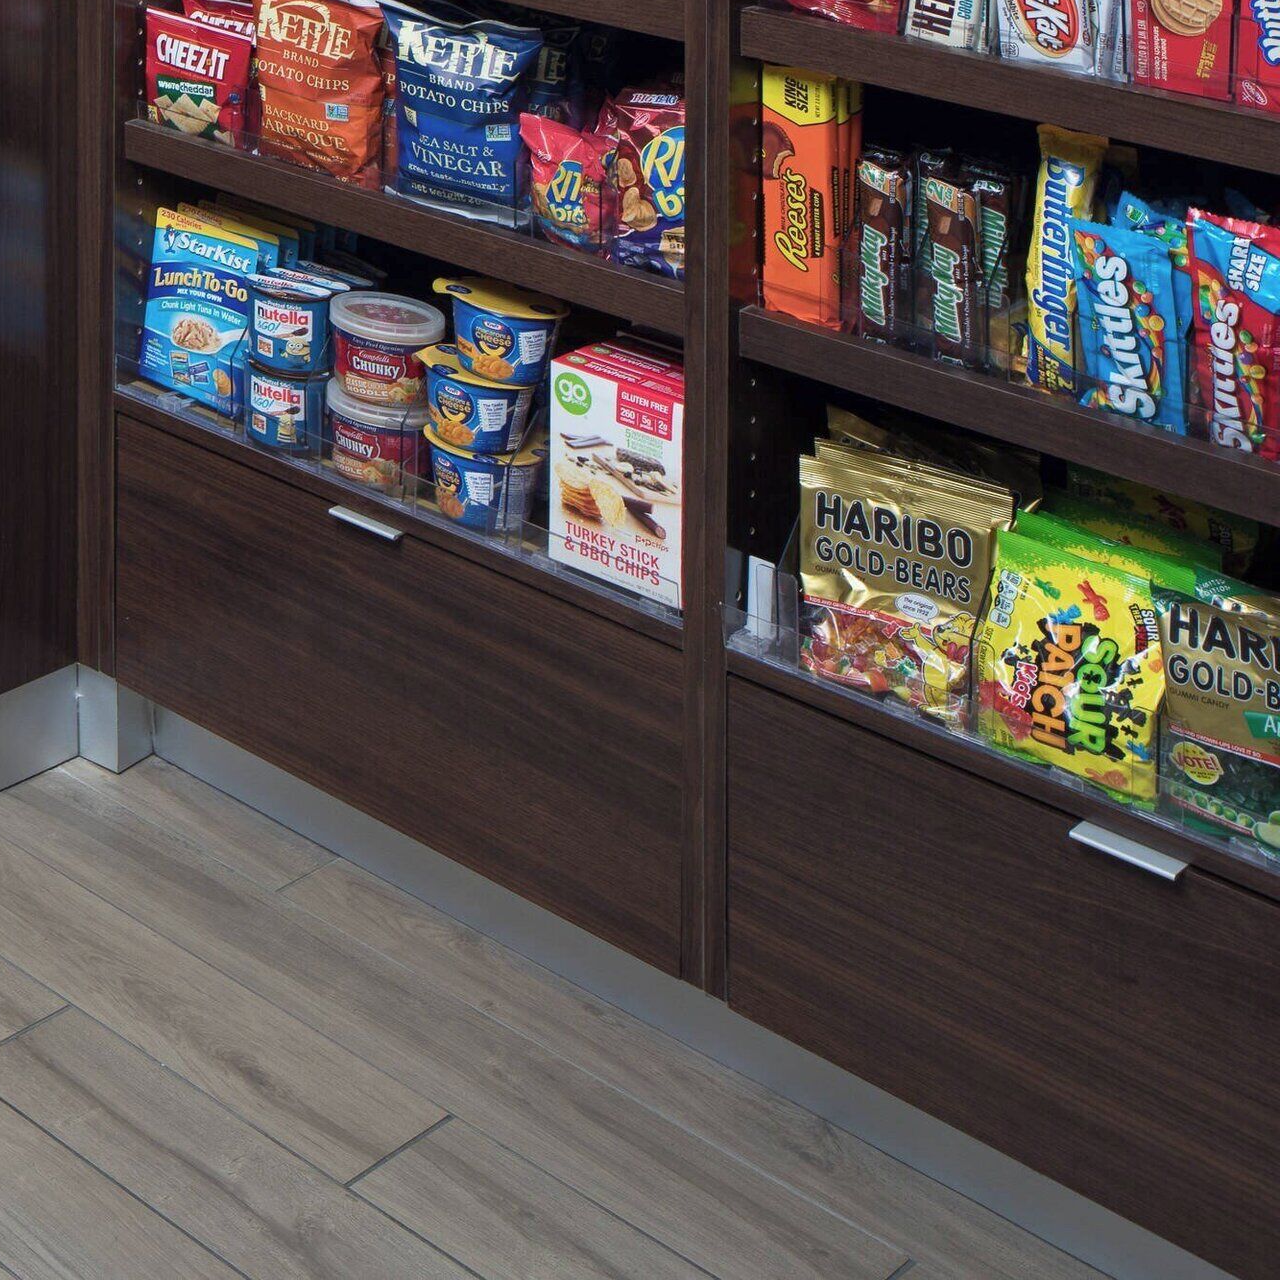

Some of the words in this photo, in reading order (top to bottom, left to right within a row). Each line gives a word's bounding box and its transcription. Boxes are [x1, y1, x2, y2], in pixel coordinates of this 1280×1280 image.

[396, 19, 521, 84] KETTLE
[1152, 24, 1160, 56] sandwich
[282, 49, 320, 69] BRAND
[157, 80, 180, 91] WHITE
[179, 82, 214, 97] cheddar
[400, 79, 456, 108] POTATO
[461, 98, 510, 114] CHIPS
[429, 73, 475, 93] BRAND
[783, 76, 798, 109] KING
[796, 80, 810, 113] SIZE
[265, 103, 330, 133] BACKYARD
[410, 140, 508, 178] VINEGAR
[443, 140, 479, 158] SALT
[482, 146, 495, 157] &
[161, 209, 176, 221] 230
[176, 215, 203, 231] Calories
[773, 167, 809, 272] Reese's
[176, 233, 251, 274] StarKist
[1032, 154, 1086, 352] Butterfinger
[1228, 236, 1252, 292] SHARE
[1245, 253, 1267, 294] SIZE
[257, 304, 309, 326] nutella
[1093, 254, 1157, 419] Skittles
[352, 355, 400, 379] CHUNKY
[1211, 297, 1253, 455] Skittles
[252, 379, 301, 404] nutella
[346, 385, 389, 397] NOODLE
[558, 378, 587, 402] go
[621, 391, 650, 408] GLUTEN
[650, 400, 669, 415] FREE
[641, 415, 652, 426] 5g
[658, 420, 668, 432] 2g
[335, 431, 374, 458] CHUNKY
[565, 520, 615, 552] TURKEY
[620, 543, 660, 570] STICK
[816, 491, 973, 568] HARIBO
[564, 535, 575, 552] &
[580, 541, 611, 568] BBQ
[614, 555, 660, 587] CHIPS
[815, 535, 972, 604] GOLD-BEARS
[1140, 609, 1160, 643] SOUR
[1011, 660, 1038, 710] Kids
[1030, 622, 1083, 750] PATCH
[1066, 634, 1120, 755] SOUR
[1169, 686, 1200, 704] GUMMI
[1200, 694, 1231, 711] CANDY
